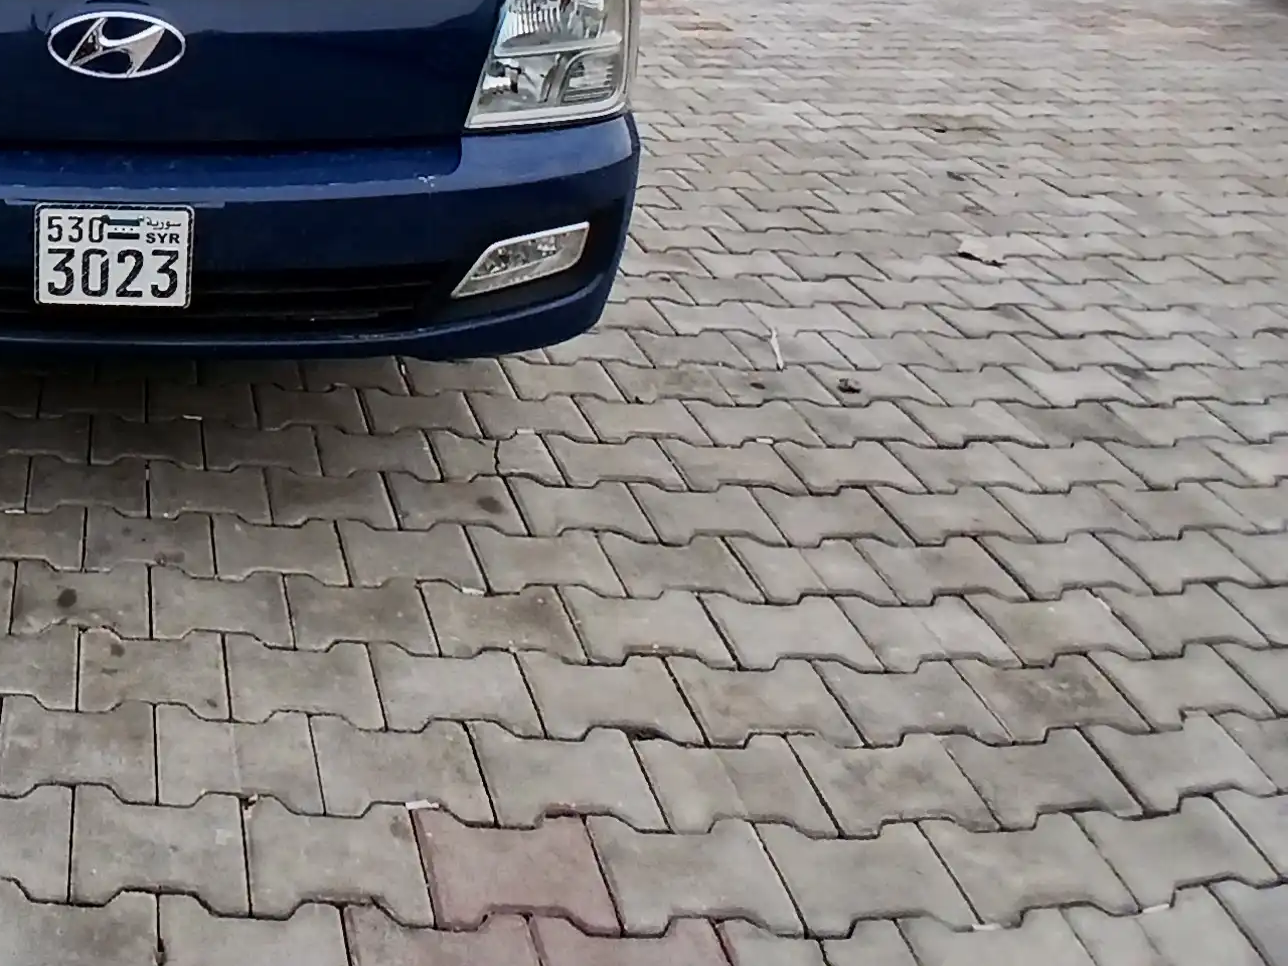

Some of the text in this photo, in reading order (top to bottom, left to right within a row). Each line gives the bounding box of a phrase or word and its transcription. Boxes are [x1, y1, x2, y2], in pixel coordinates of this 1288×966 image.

[47, 216, 106, 243] 530
[146, 233, 180, 244] SYR
[47, 248, 180, 298] 3023
